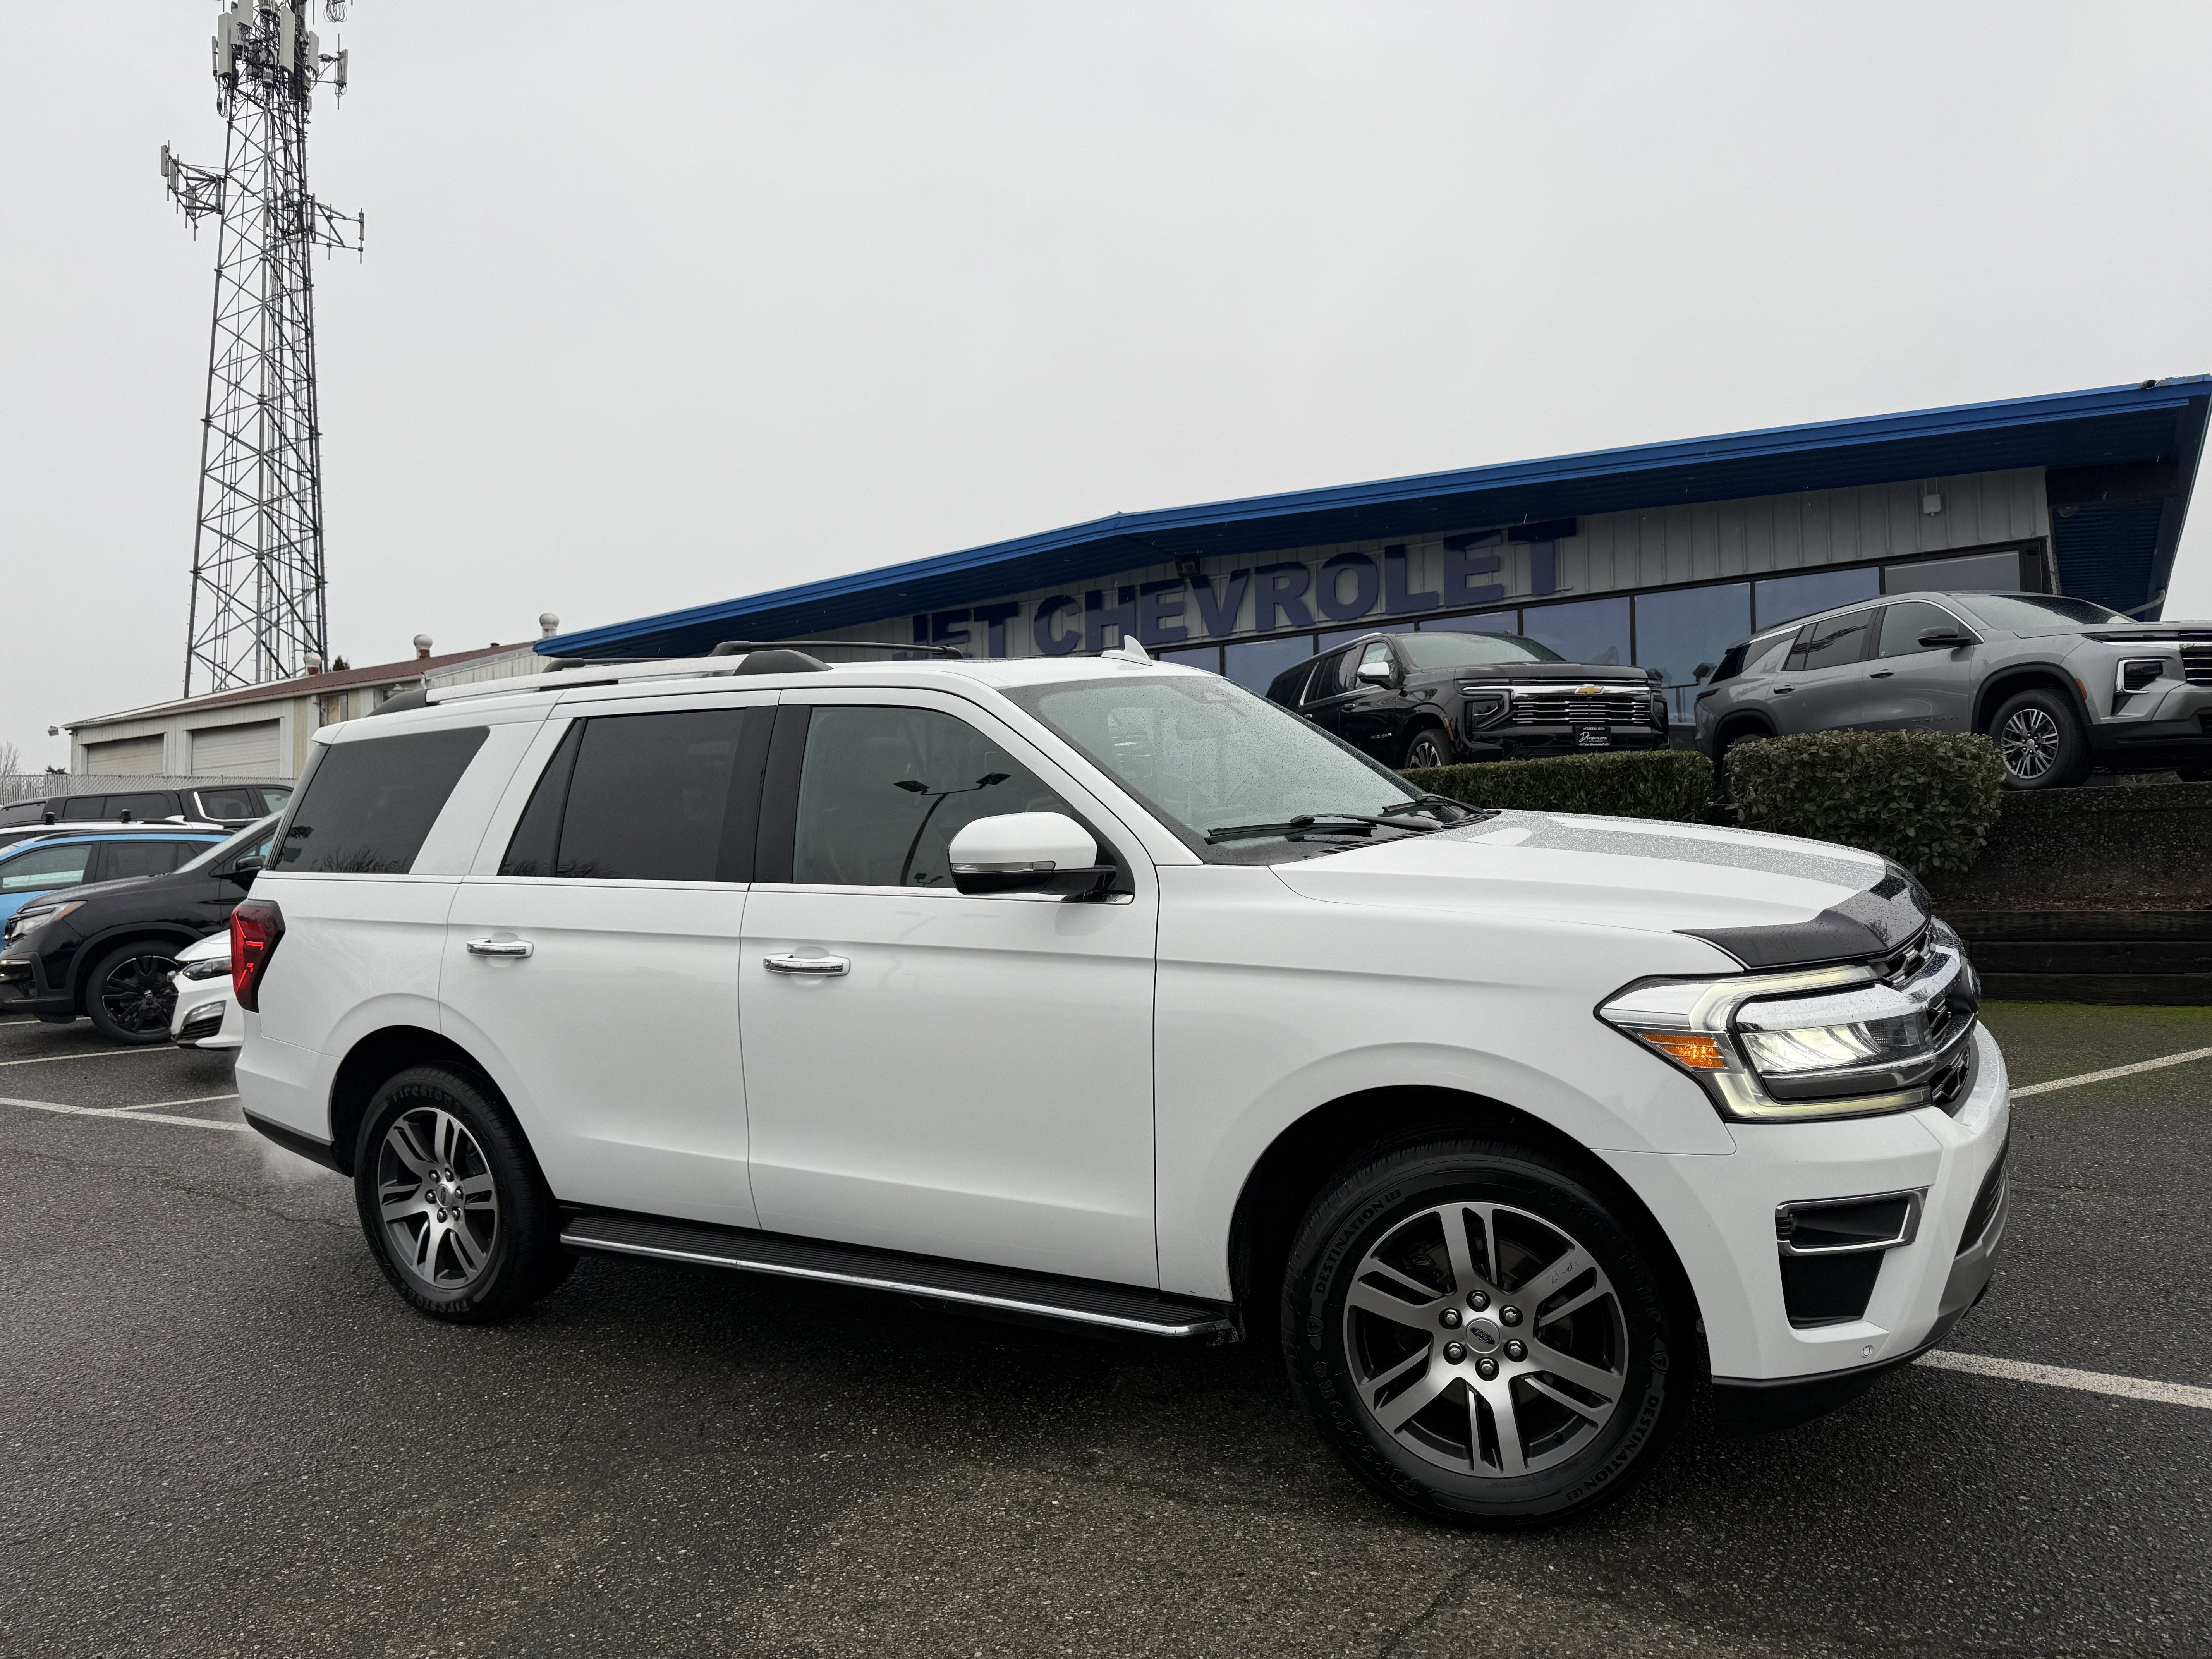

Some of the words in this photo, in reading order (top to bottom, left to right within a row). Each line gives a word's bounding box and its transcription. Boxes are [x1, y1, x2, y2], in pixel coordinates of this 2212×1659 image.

[892, 601, 1019, 661] JET
[1033, 517, 1577, 656] CHEVROLET
[1315, 1200, 1385, 1294] DESTINATION
[1384, 1188, 1401, 1203] LE3
[1473, 1329, 1492, 1343] Ford
[1313, 1361, 1419, 1496] Firestone
[1583, 1395, 1660, 1491] DESTINATION
[1566, 1487, 1584, 1501] LE3
